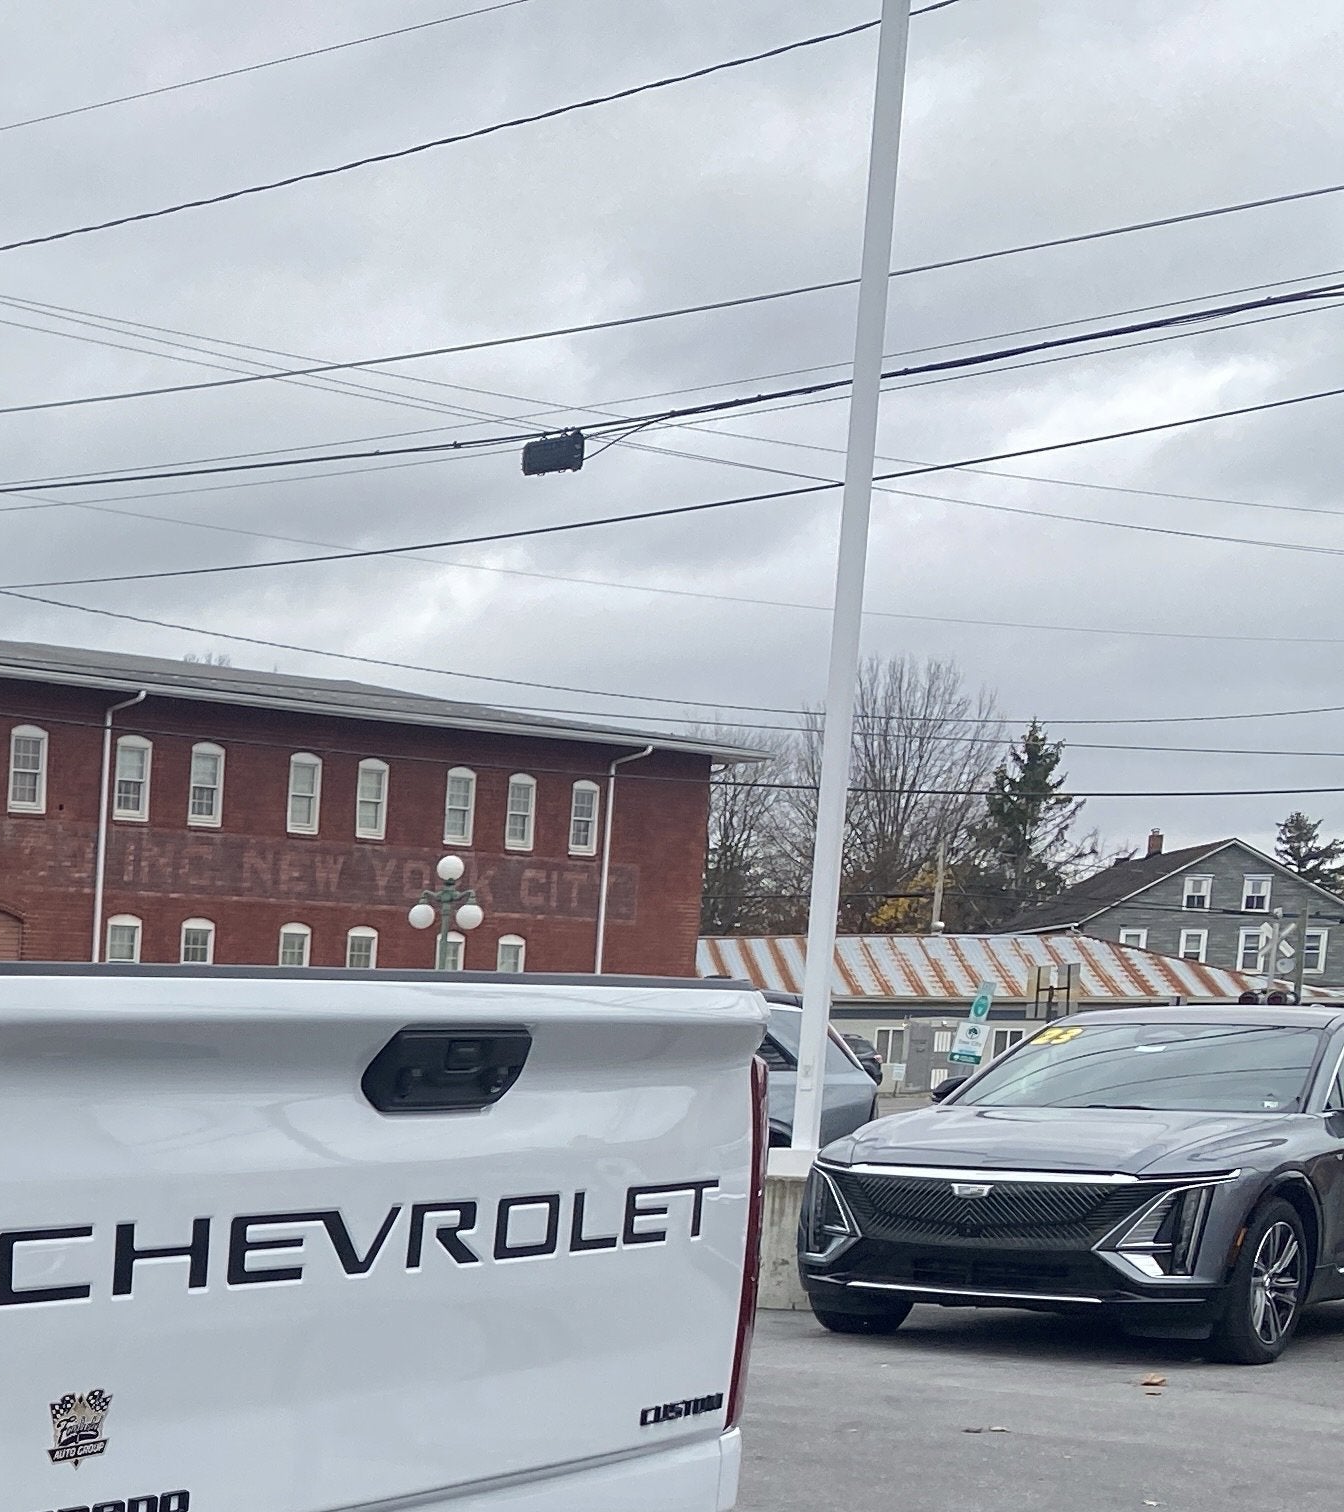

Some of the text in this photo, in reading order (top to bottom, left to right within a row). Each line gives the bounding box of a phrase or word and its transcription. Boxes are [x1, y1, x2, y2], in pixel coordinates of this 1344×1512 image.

[242, 849, 344, 894] NEW
[640, 1393, 724, 1426] CUSTOM
[54, 1442, 105, 1460] AUTO GROUP
